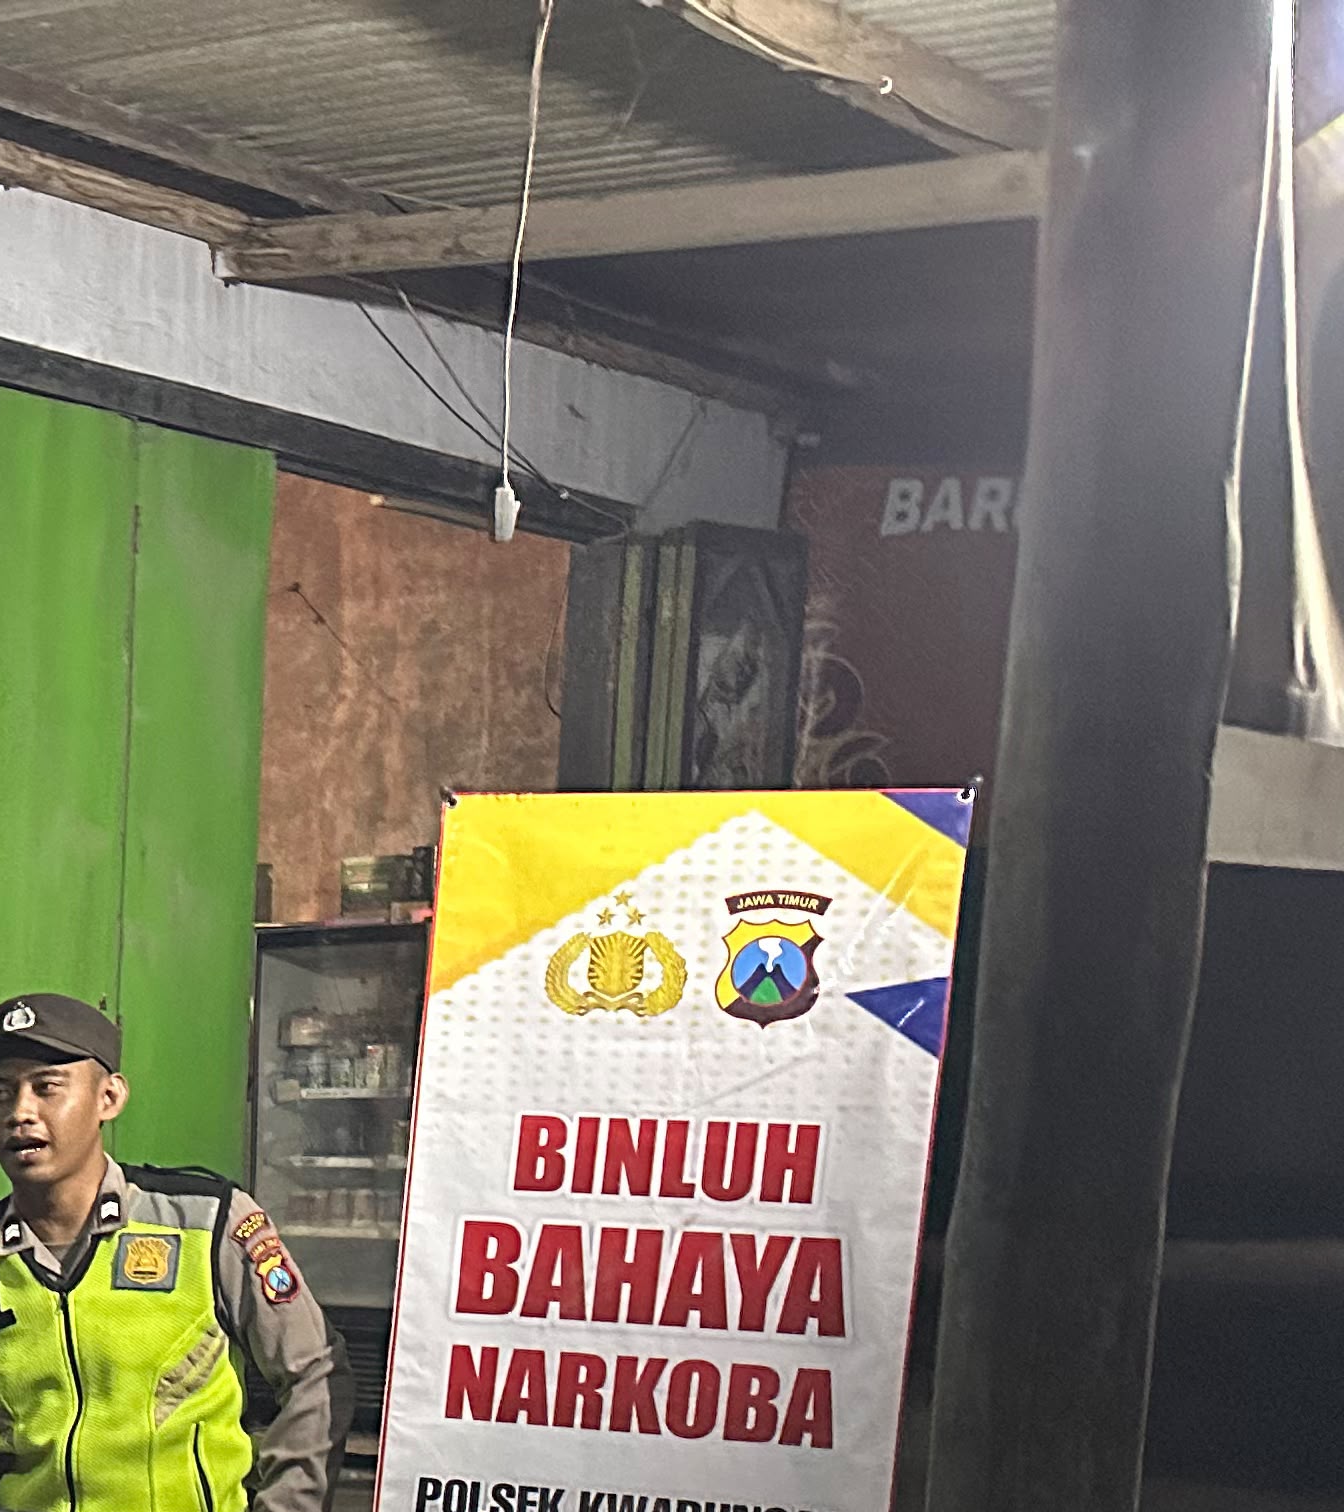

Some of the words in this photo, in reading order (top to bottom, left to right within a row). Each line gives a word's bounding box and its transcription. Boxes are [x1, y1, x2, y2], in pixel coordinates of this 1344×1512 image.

[880, 477, 1012, 536] BAR
[737, 894, 774, 909] JAWA
[778, 894, 819, 910] TIMUR
[513, 1114, 821, 1204] BINLUH
[455, 1220, 846, 1338] BAHAYA
[444, 1344, 833, 1449] NARKOBA
